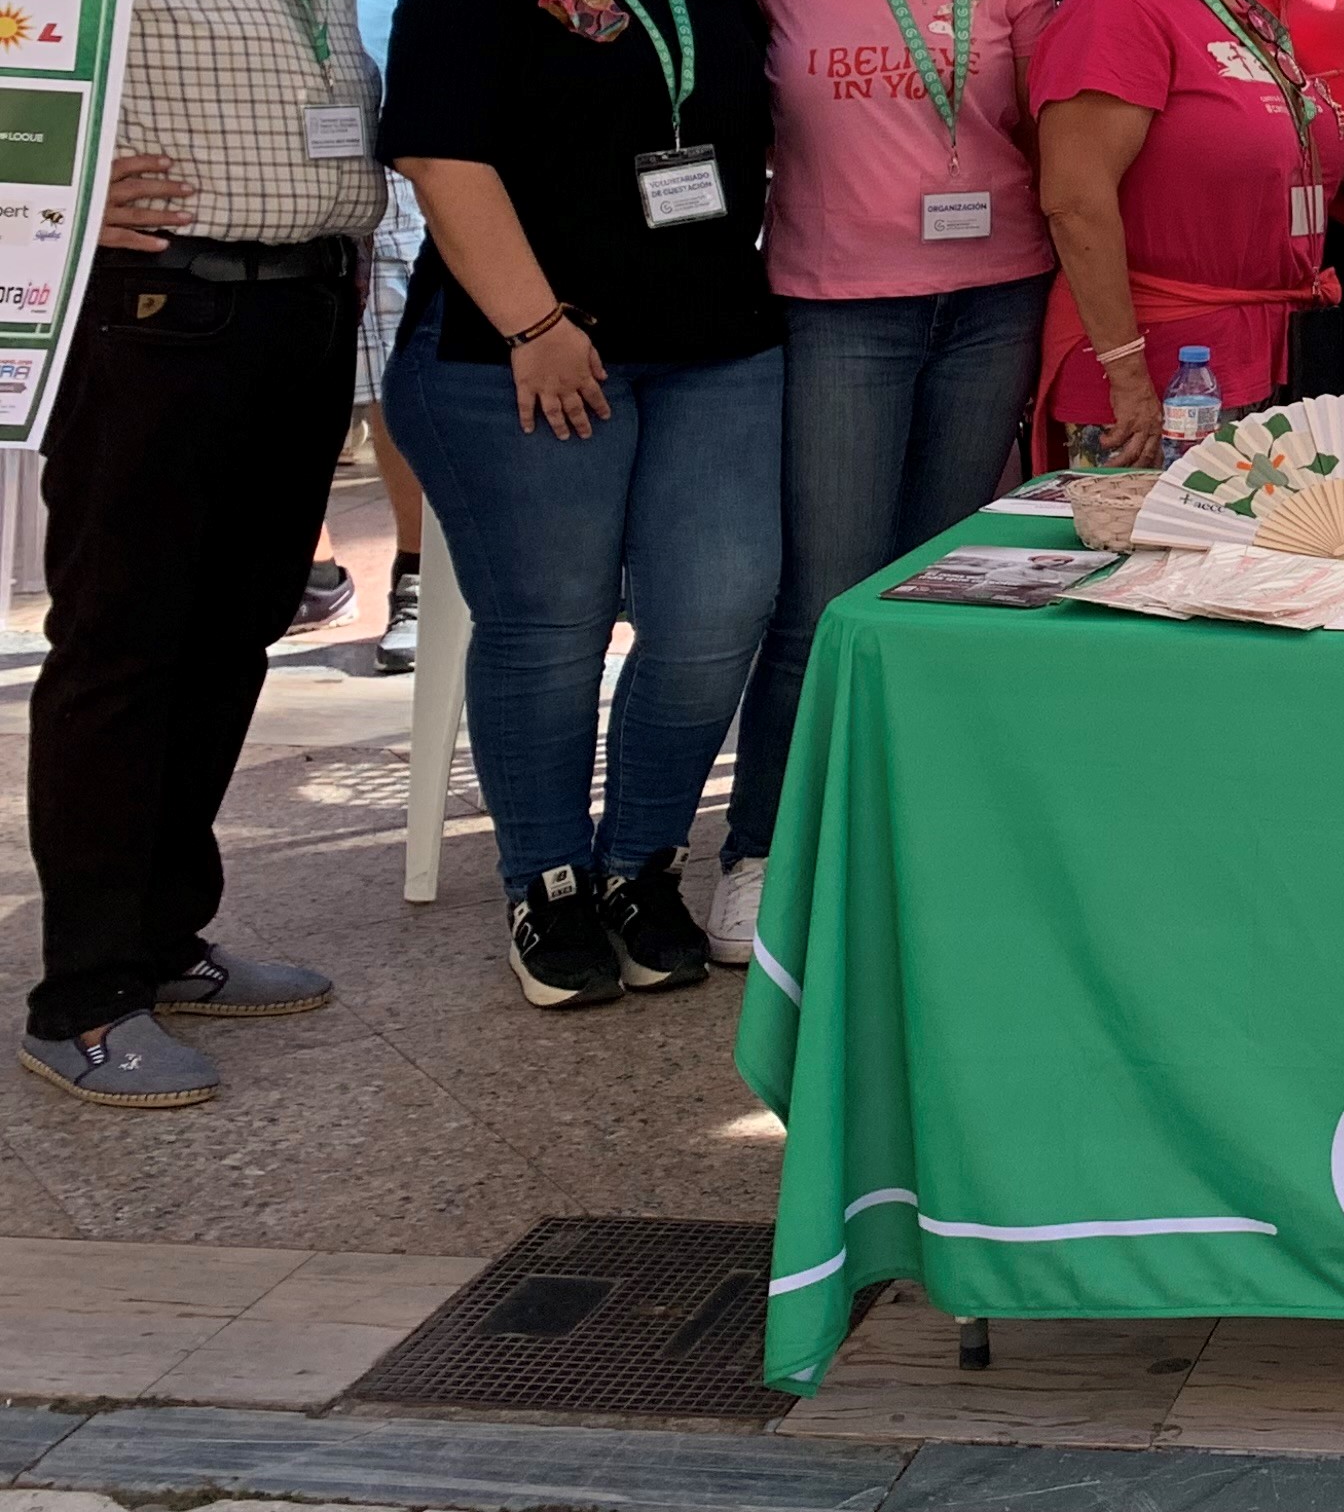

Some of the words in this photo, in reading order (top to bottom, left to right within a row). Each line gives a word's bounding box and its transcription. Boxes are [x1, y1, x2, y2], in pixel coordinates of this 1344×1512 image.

[807, 49, 817, 76] I
[827, 46, 981, 78] BELIVE
[833, 78, 873, 100] IN
[882, 71, 956, 101] YO
[0, 205, 29, 218] ert
[927, 201, 987, 213] ORGANIZACIÓN
